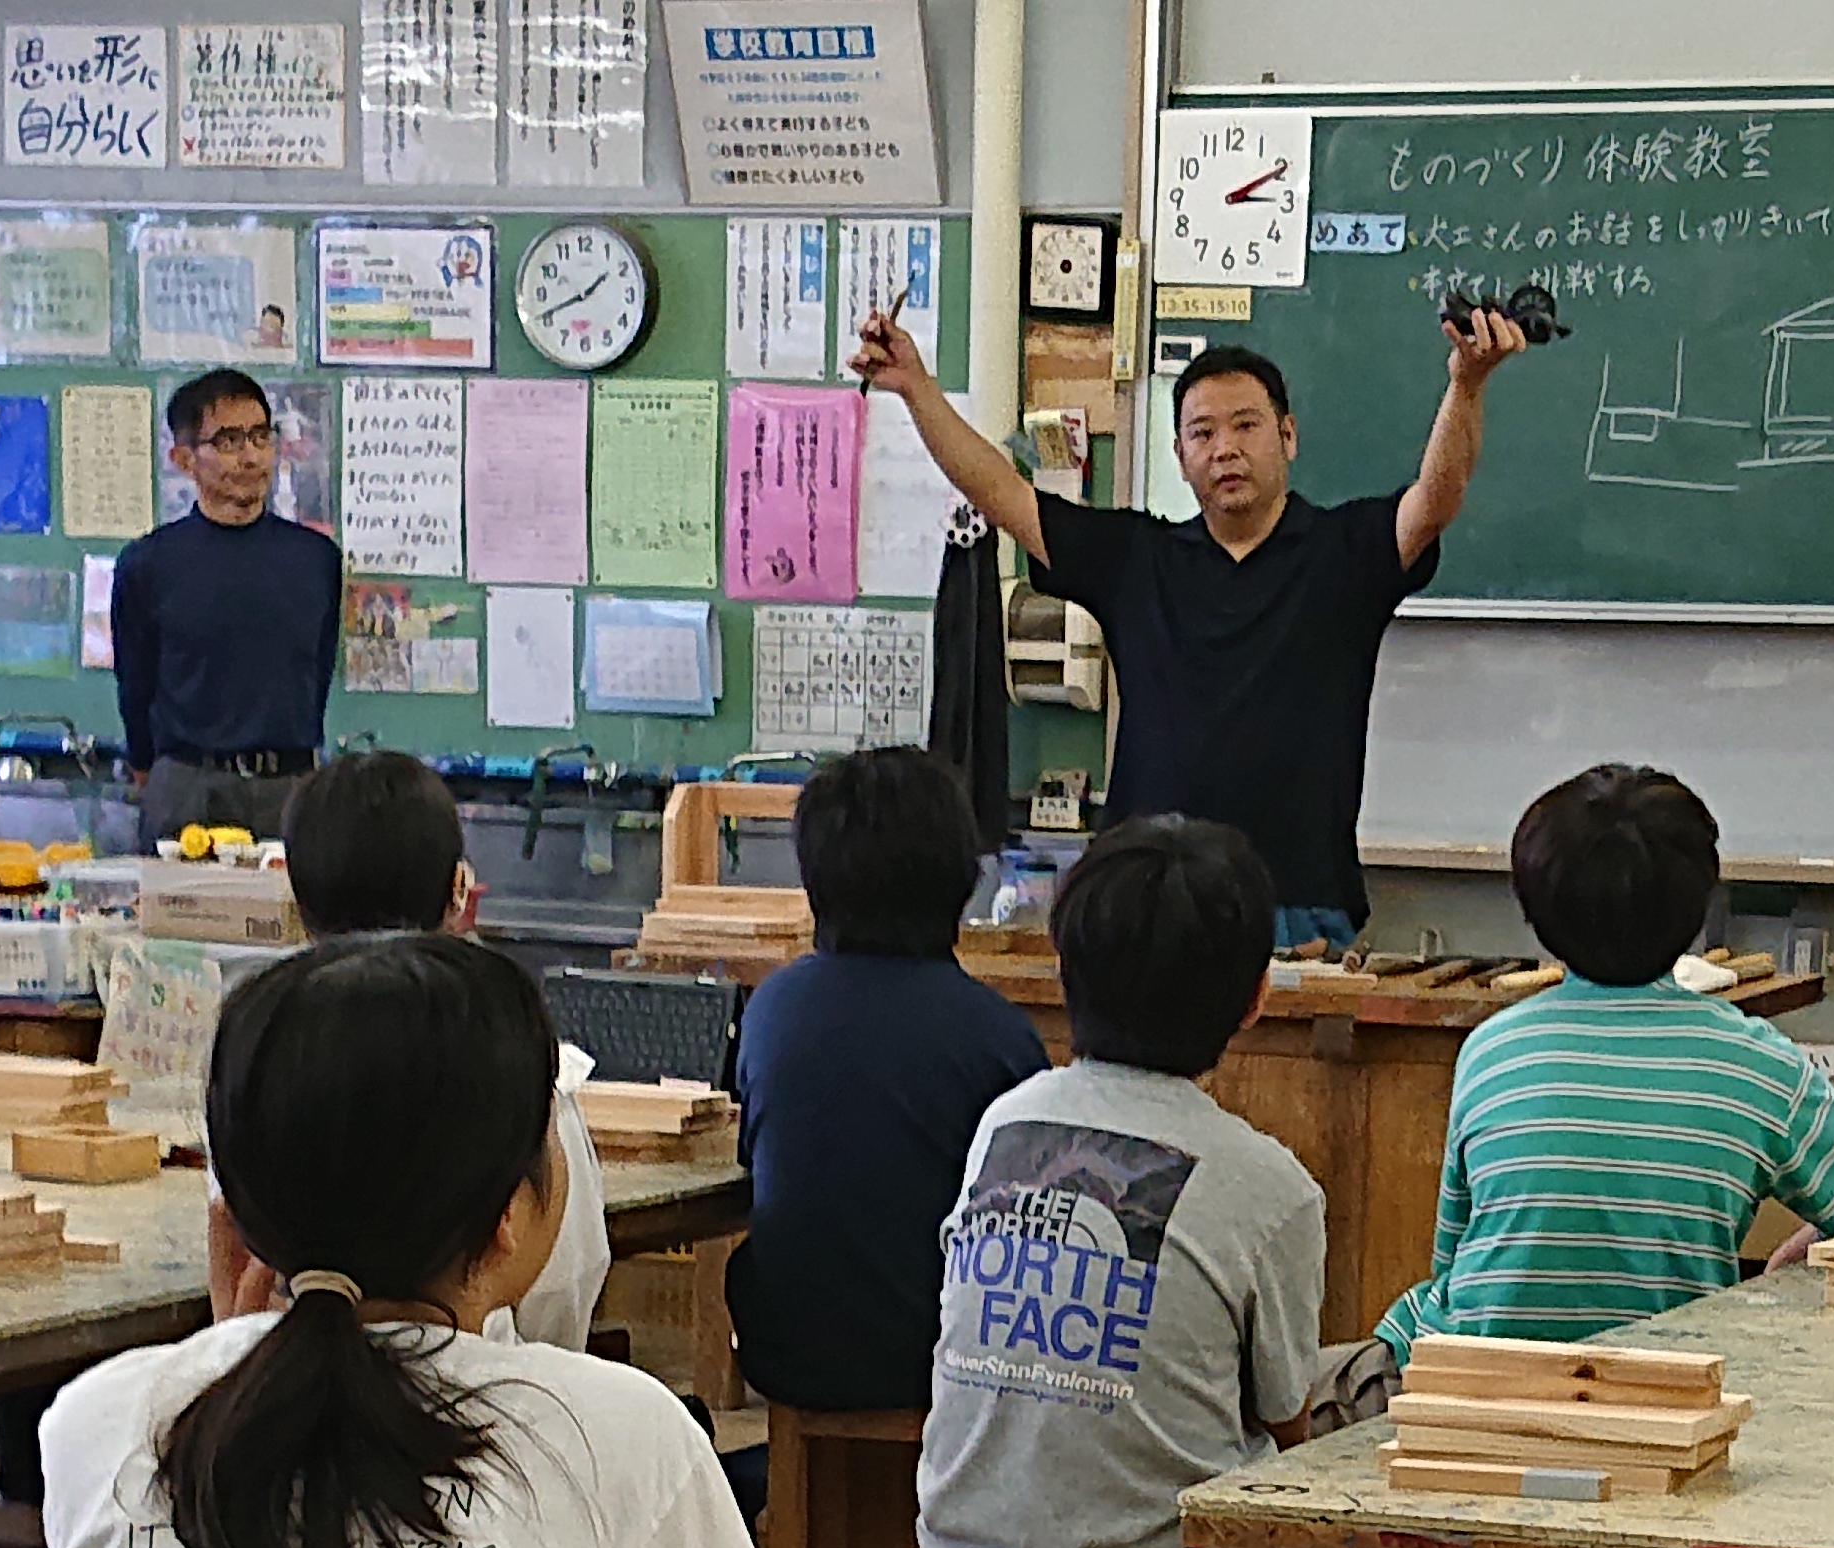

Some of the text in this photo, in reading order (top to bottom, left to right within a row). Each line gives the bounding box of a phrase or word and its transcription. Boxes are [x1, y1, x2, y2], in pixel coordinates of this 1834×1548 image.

[18, 97, 159, 157] 自分らしく
[1226, 127, 1245, 151] 12
[1203, 134, 1217, 157] 11
[1180, 157, 1200, 180] 10
[1169, 187, 1185, 211] 9
[1280, 189, 1294, 213] 3
[1175, 215, 1189, 238] 8
[1267, 219, 1281, 244] 4
[1314, 220, 1402, 246] めあて
[1194, 239, 1208, 262] 7
[1221, 247, 1235, 270] 6
[1247, 241, 1260, 265] 5
[1015, 1186, 1077, 1220] THE
[949, 1233, 1158, 1315] NORTH
[979, 1290, 1148, 1372] FACE
